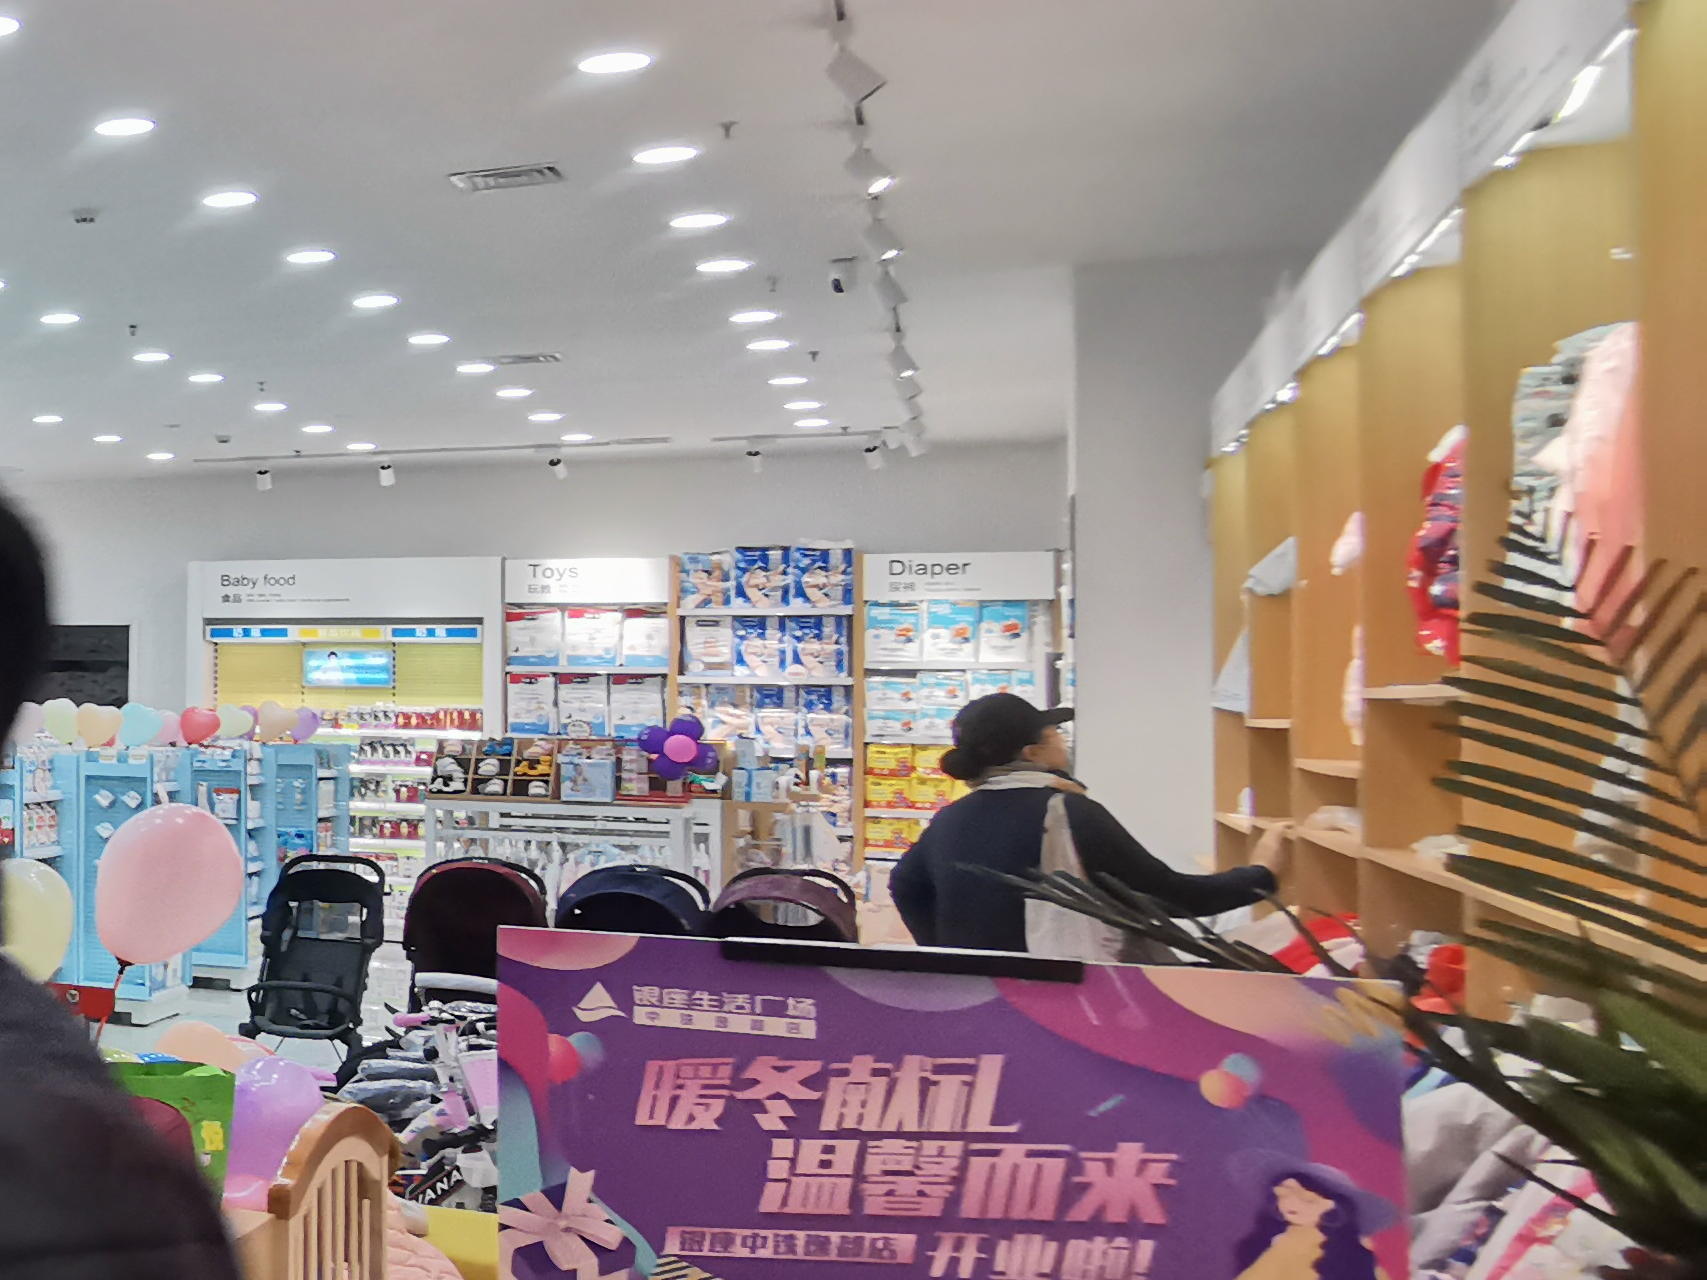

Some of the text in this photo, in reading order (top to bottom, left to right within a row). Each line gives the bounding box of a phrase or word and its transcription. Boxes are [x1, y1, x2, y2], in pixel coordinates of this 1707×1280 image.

[220, 574, 296, 590] Baby food
[528, 563, 579, 581] Toys
[888, 559, 972, 579] Diaper
[632, 985, 817, 1019] 银座生活广场
[634, 1053, 1021, 1133] 暖冬献礼
[758, 1138, 1180, 1225] 温馨而来
